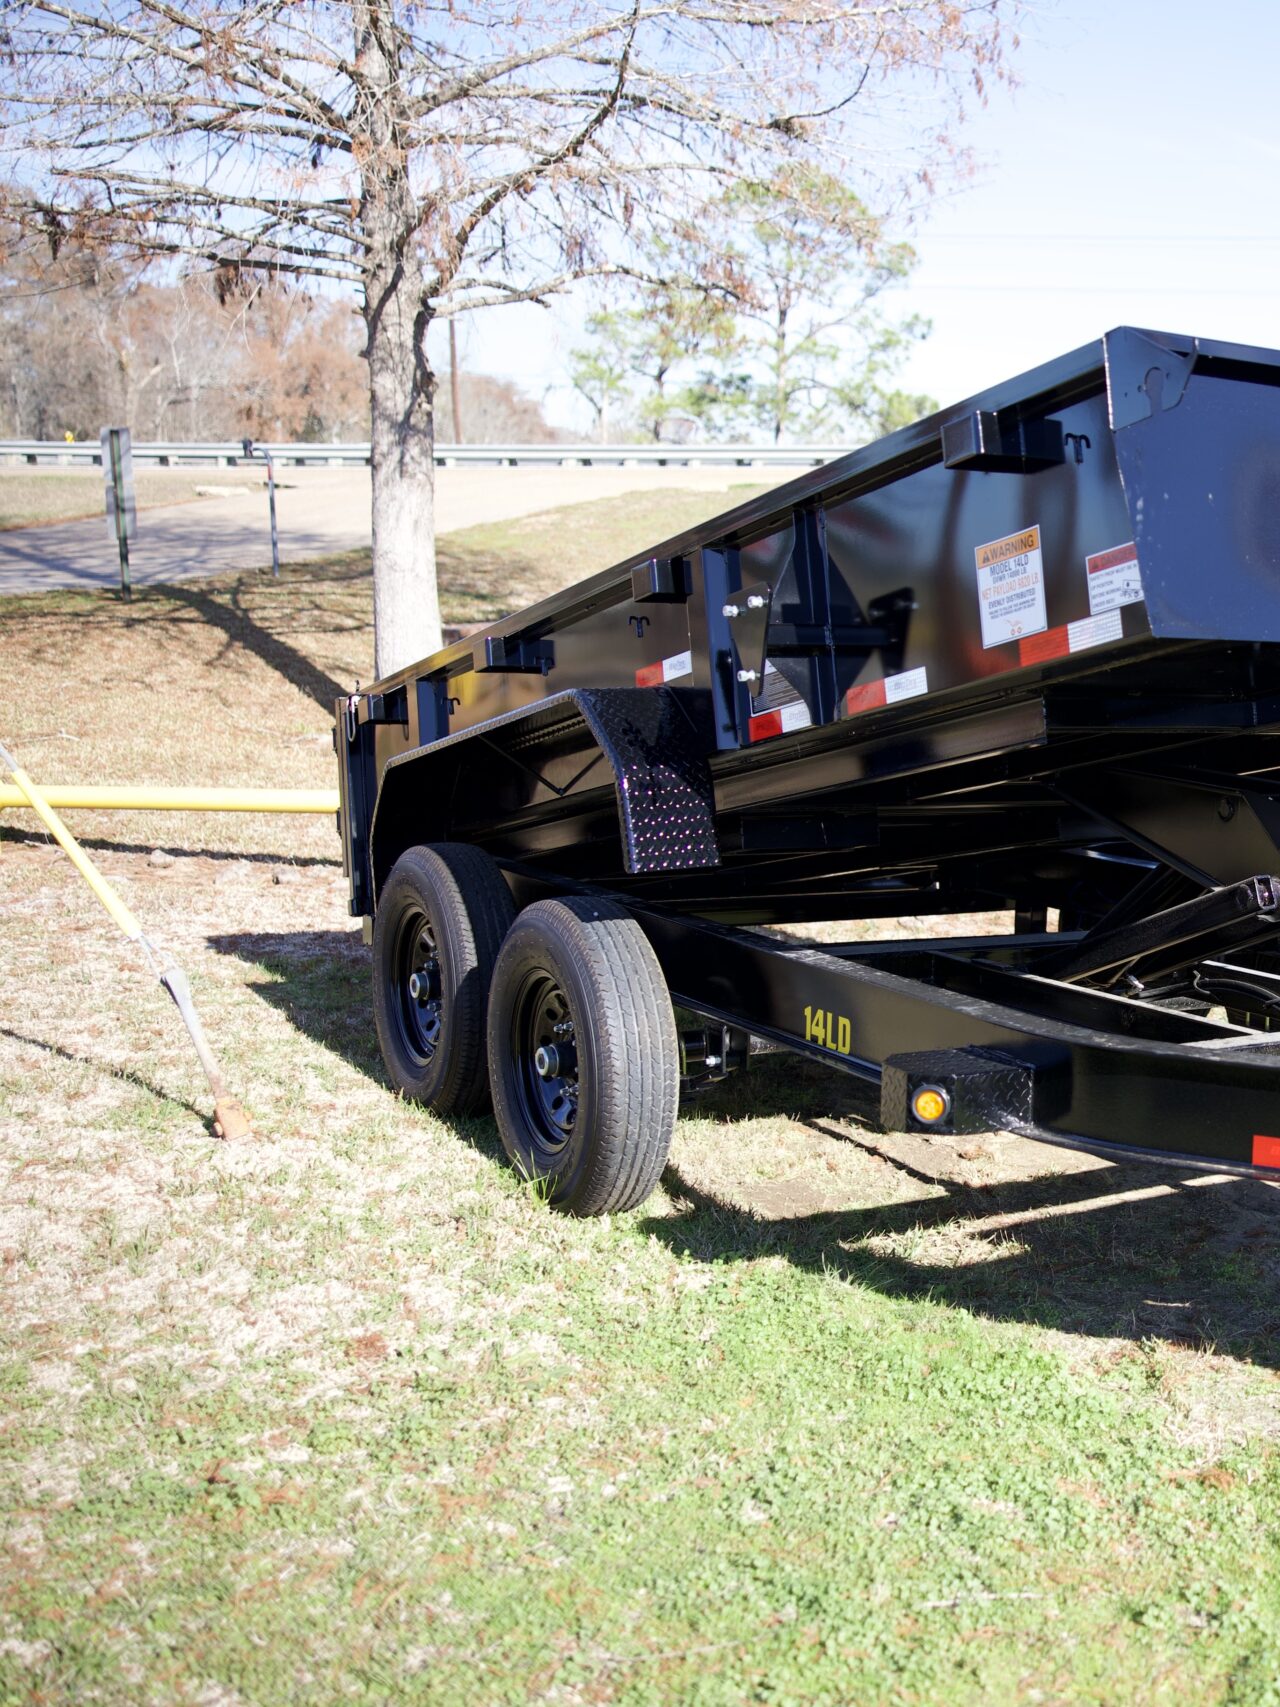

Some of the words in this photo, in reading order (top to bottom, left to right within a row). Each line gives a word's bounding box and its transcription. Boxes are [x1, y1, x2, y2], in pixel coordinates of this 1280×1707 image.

[990, 534, 1034, 560] WARNING
[990, 560, 1012, 576] MODEL
[1014, 554, 1029, 568] 14LD
[982, 588, 992, 600] NET
[993, 580, 1016, 596] PAYLOAD
[804, 1005, 851, 1055] 14LD
